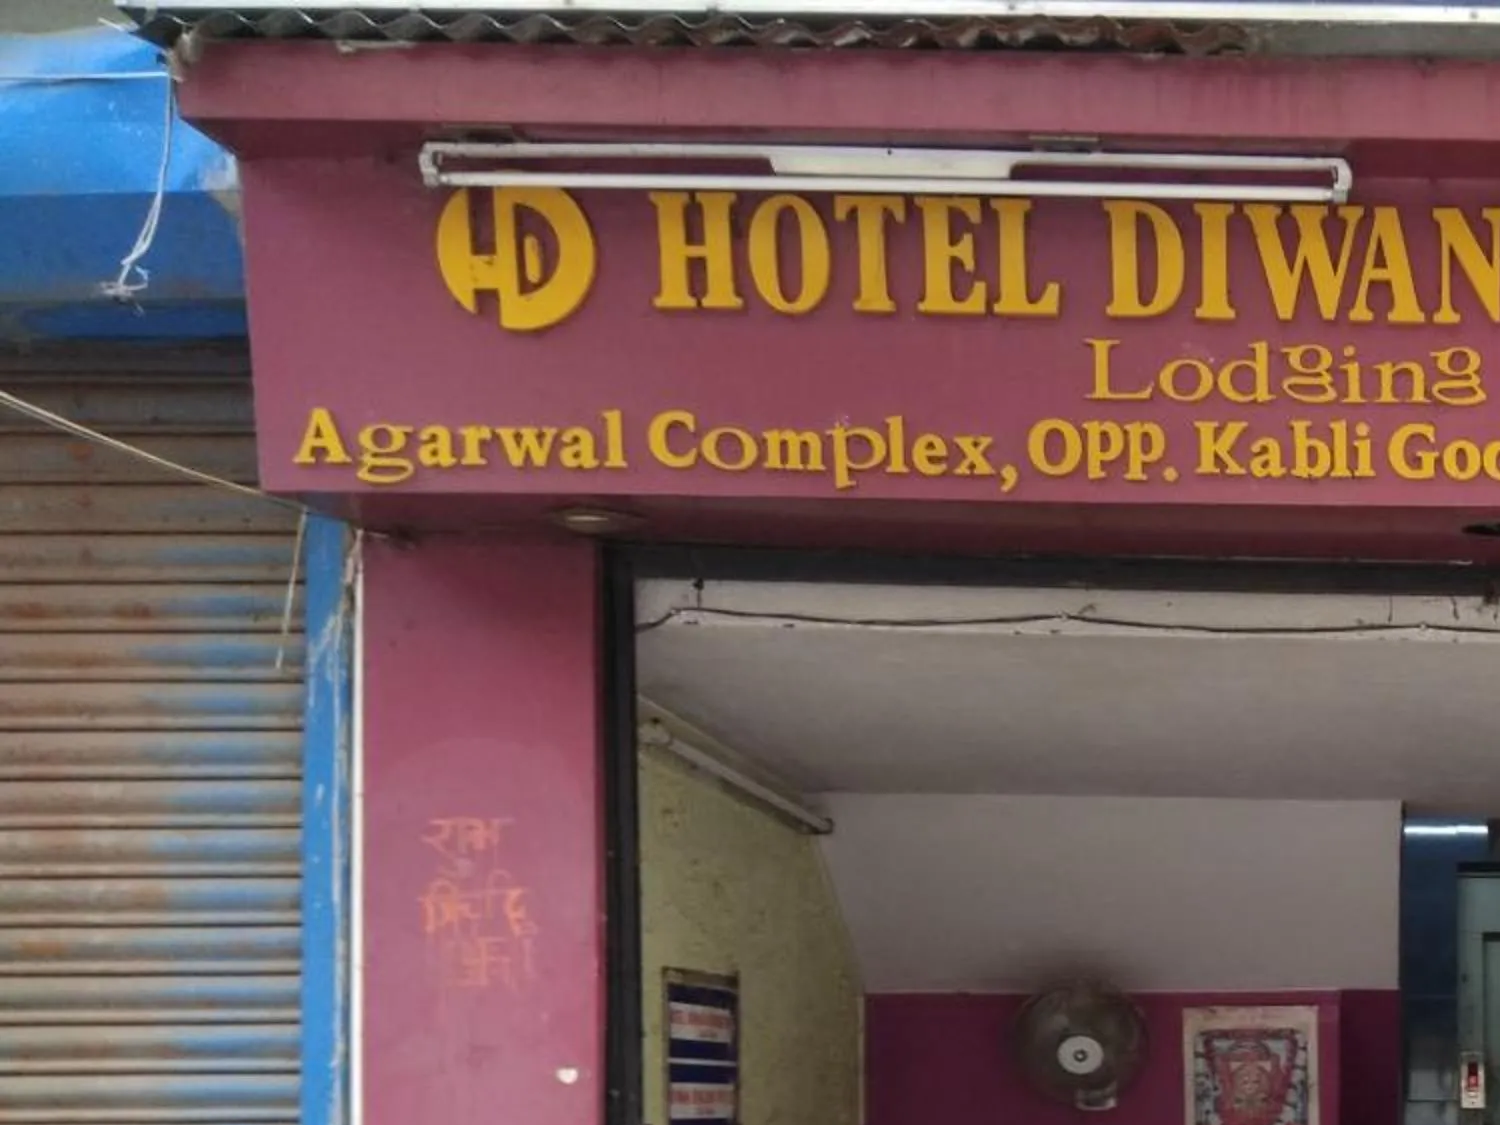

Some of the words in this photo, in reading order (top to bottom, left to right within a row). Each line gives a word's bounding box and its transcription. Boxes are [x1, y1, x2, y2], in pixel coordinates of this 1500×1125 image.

[650, 188, 1062, 317] HOTEL
[1084, 338, 1488, 406] Lodging
[293, 407, 626, 486] Agarwal
[648, 409, 1020, 492] Complex,
[1194, 419, 1376, 480] Kabli
